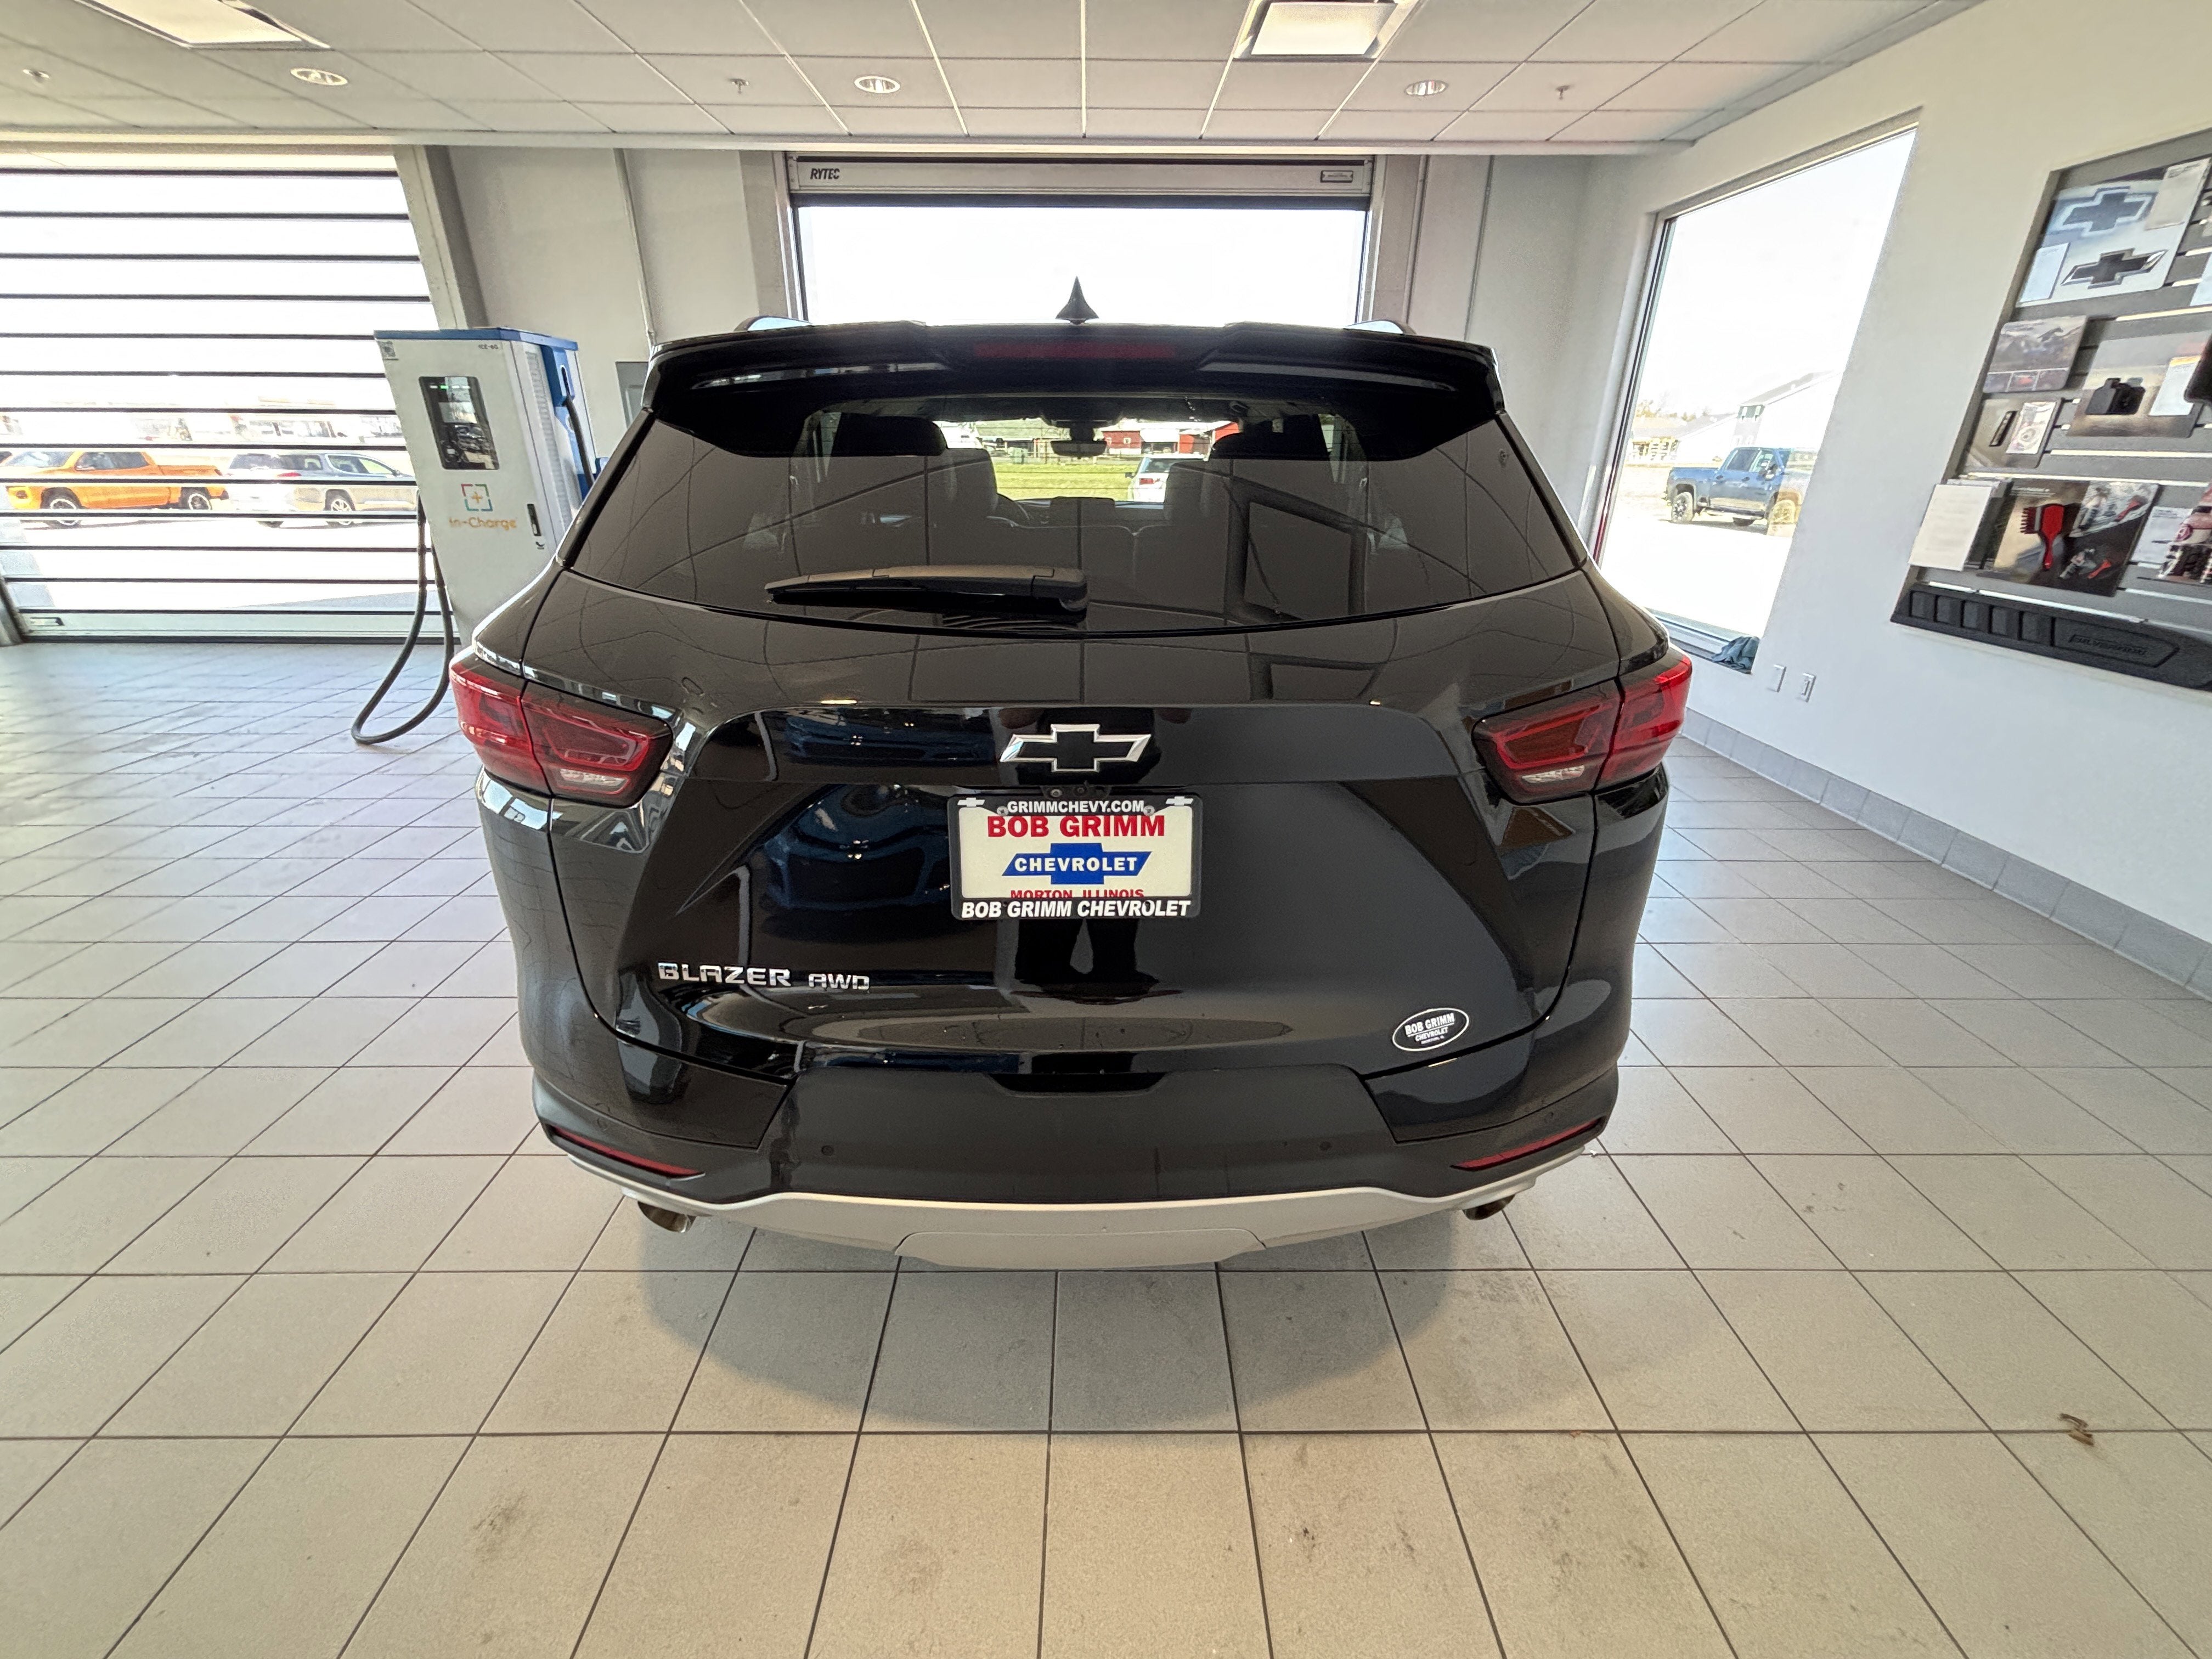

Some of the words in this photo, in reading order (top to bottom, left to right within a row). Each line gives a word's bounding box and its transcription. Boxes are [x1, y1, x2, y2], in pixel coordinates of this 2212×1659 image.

[810, 168, 840, 179] RYTEC
[449, 517, 517, 531] In-Charge
[1007, 800, 1144, 813] GRIMMCHEVY.COM
[988, 815, 1049, 837] BOB
[1059, 815, 1165, 837] GRIMM
[1014, 856, 1137, 872] CHEVROLET
[962, 901, 1002, 918] BOB
[1007, 901, 1073, 918] GRIMM
[1077, 900, 1192, 917] CHEVROLET
[658, 962, 792, 987] BLAZER
[808, 973, 870, 990] AWD
[1404, 1022, 1424, 1035] BOB
[1425, 1012, 1455, 1029] GRIMM
[1415, 1026, 1448, 1042] CHEVROLET
